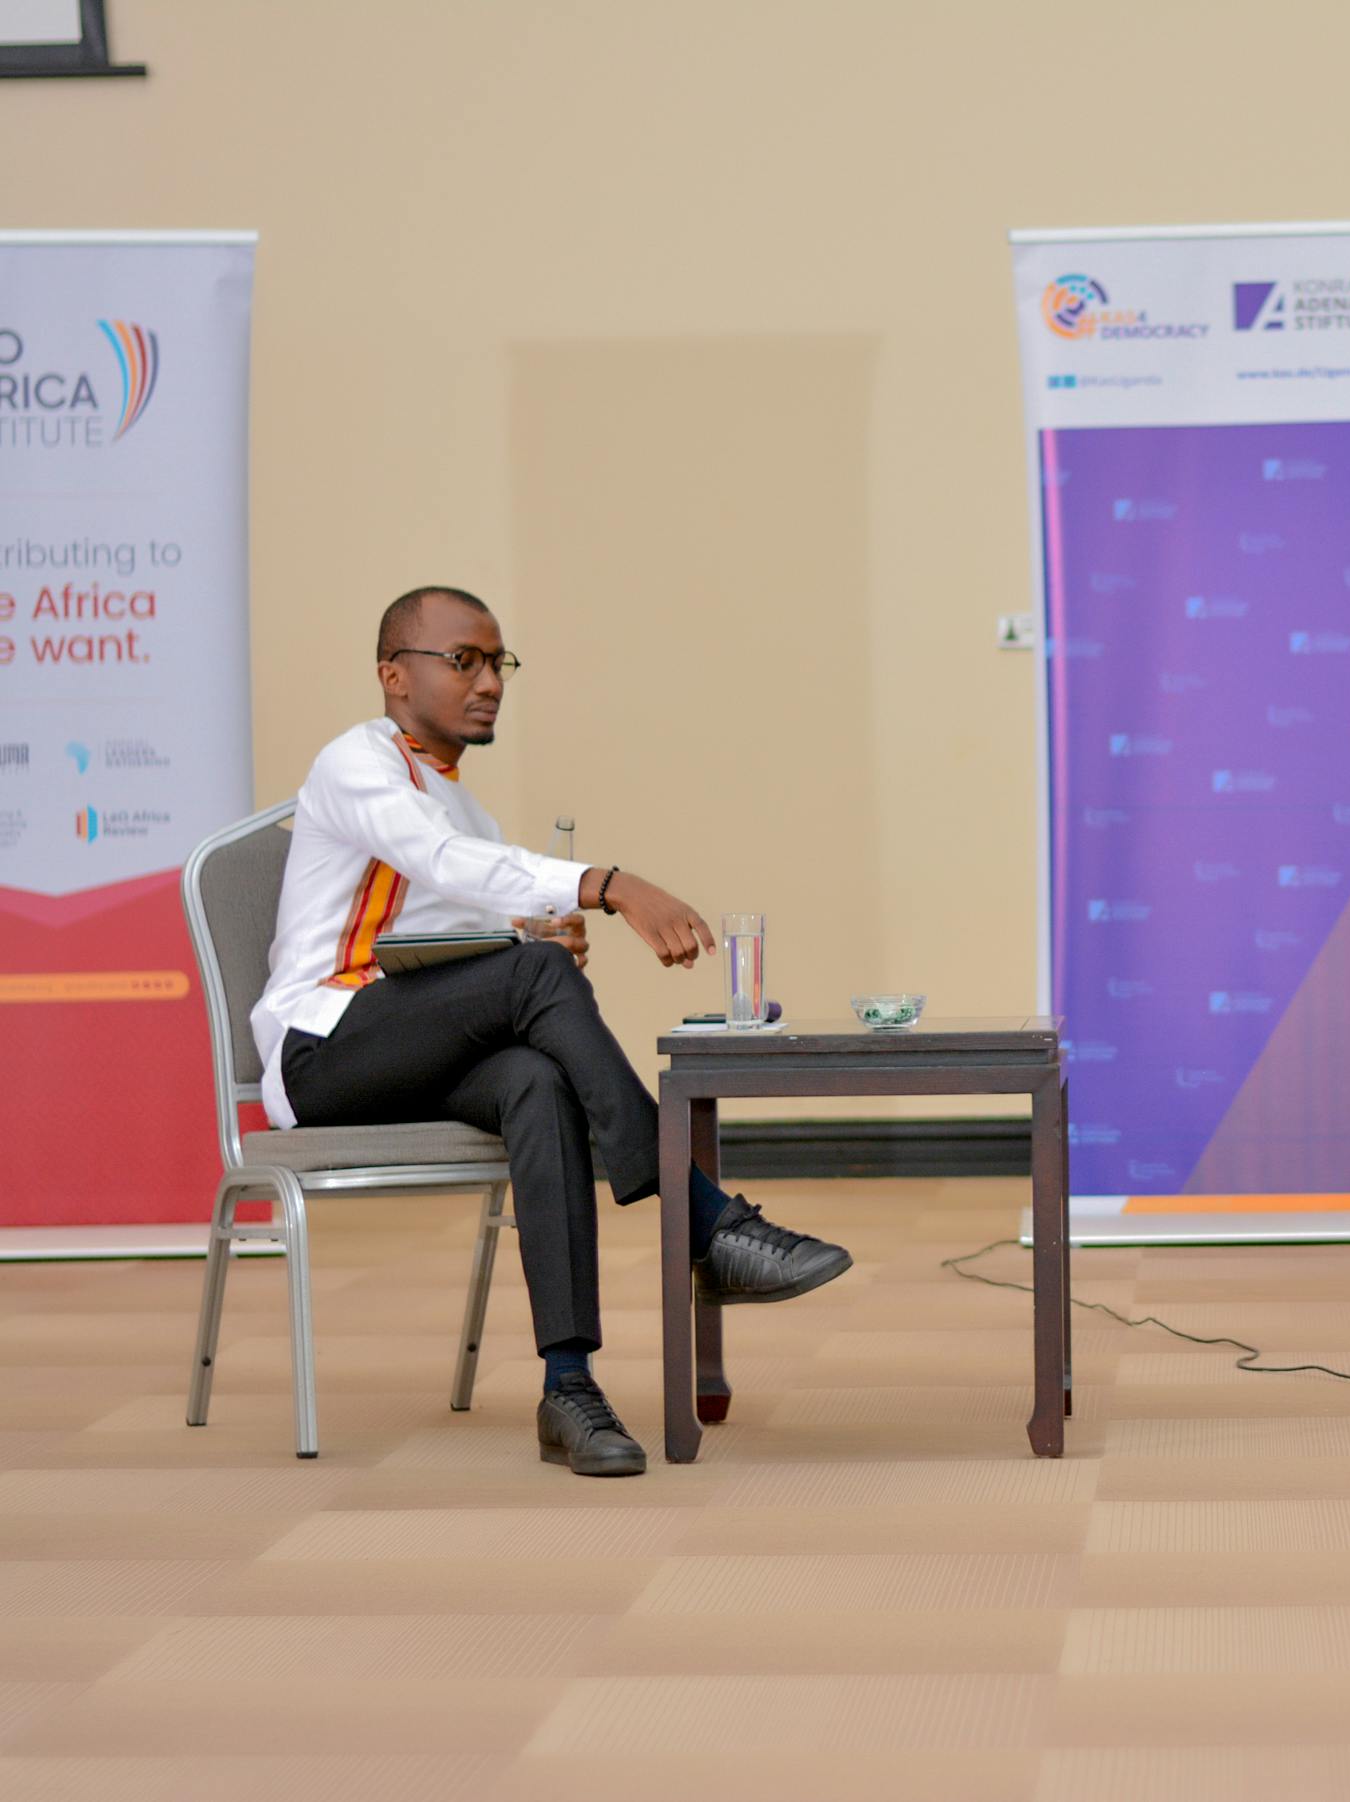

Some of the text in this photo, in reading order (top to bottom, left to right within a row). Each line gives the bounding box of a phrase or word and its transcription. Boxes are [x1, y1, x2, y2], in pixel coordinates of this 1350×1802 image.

[1100, 324, 1210, 341] DEMOCRACY
[150, 540, 183, 568] to
[32, 581, 157, 622] Africa
[30, 628, 151, 666] want.
